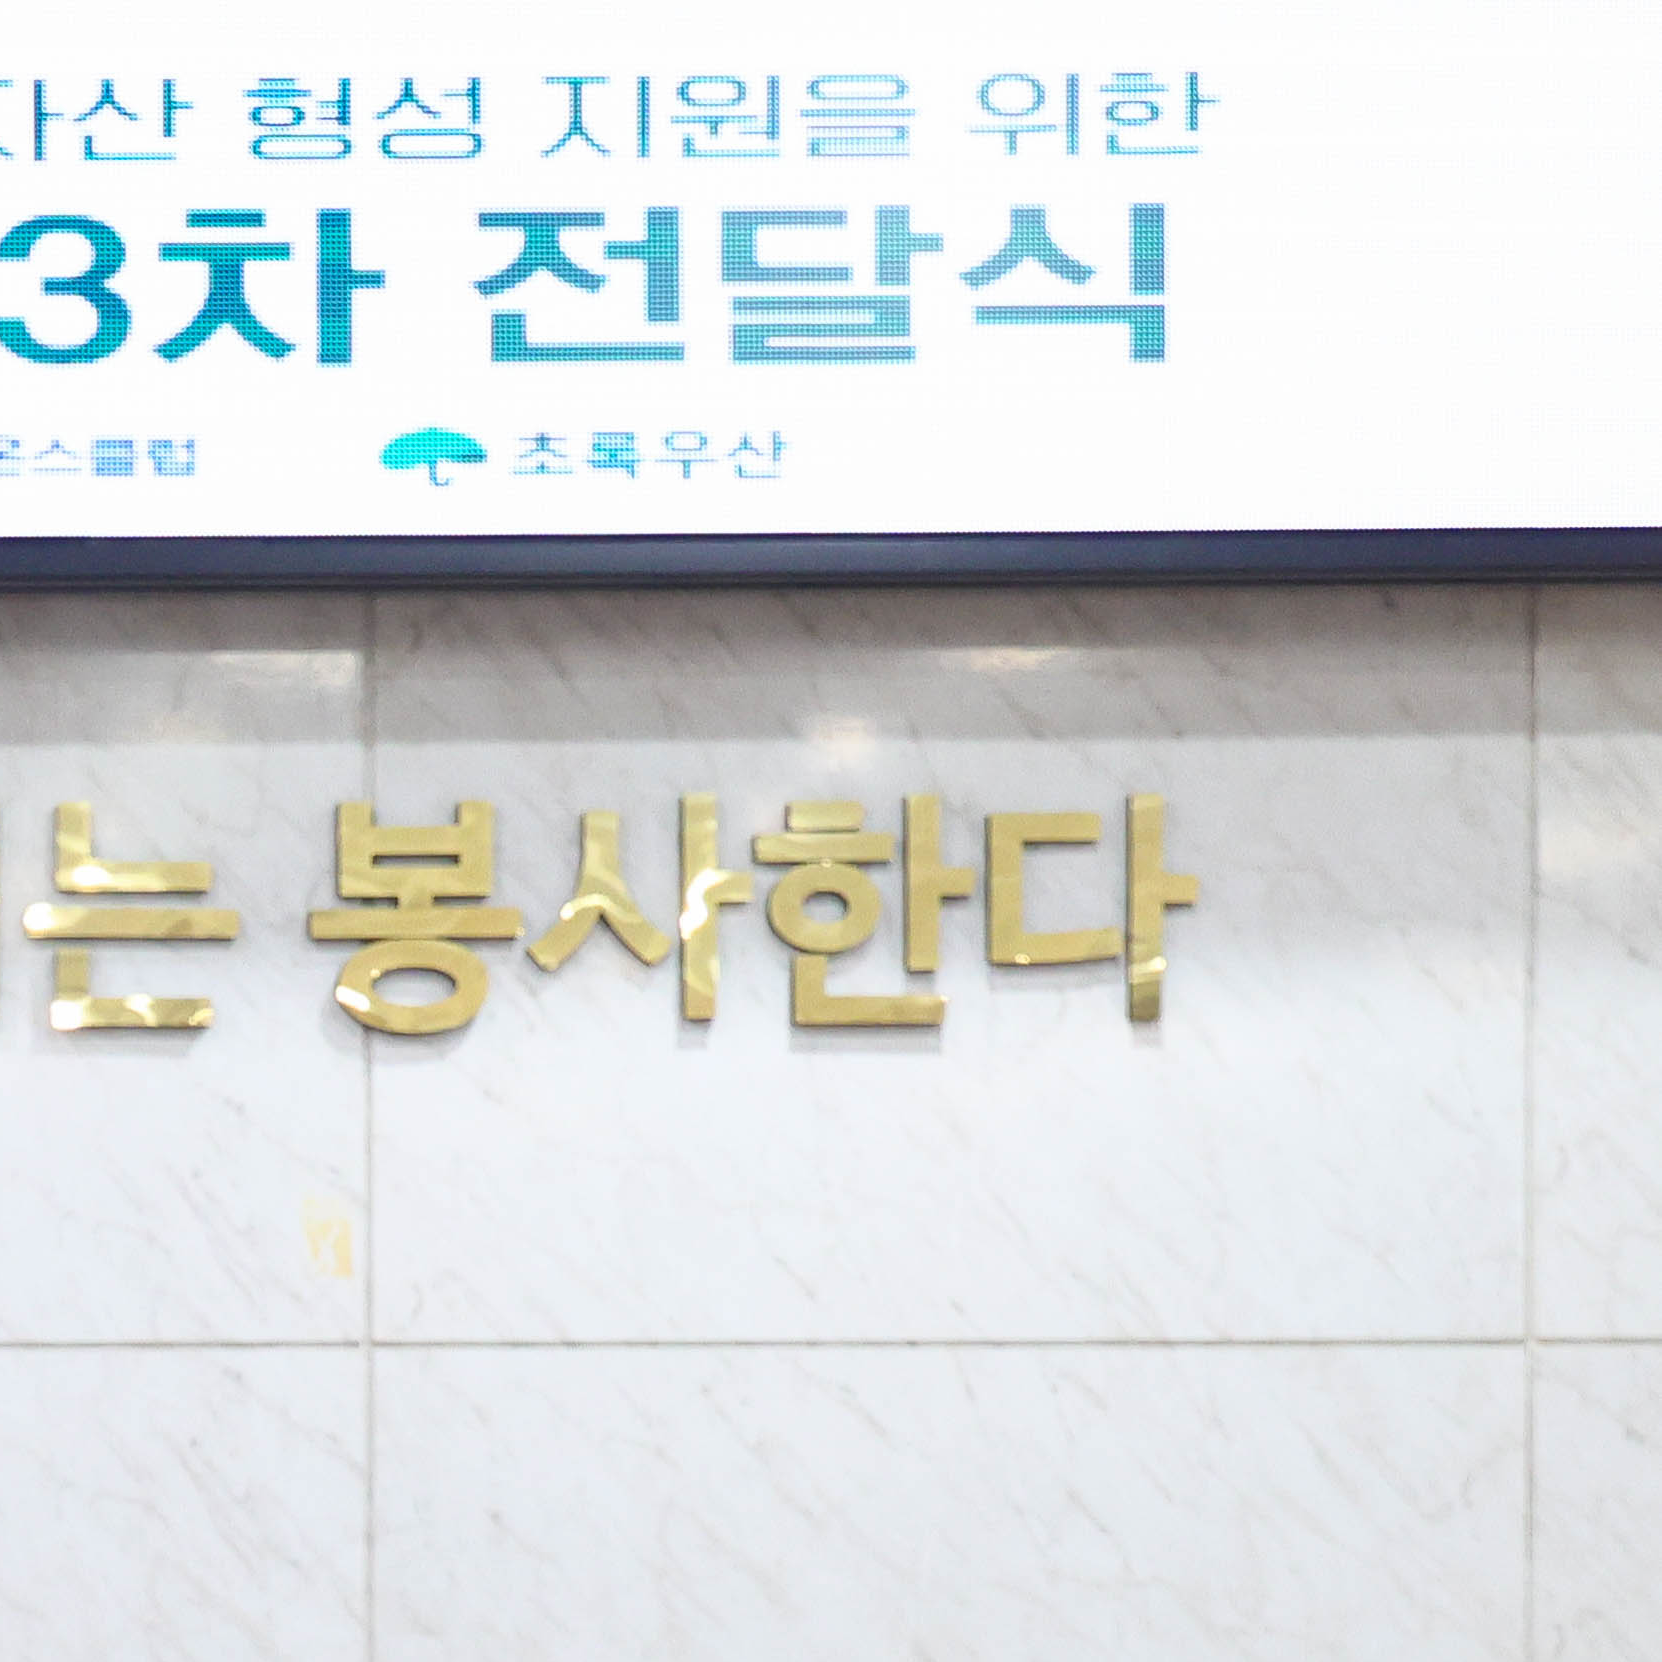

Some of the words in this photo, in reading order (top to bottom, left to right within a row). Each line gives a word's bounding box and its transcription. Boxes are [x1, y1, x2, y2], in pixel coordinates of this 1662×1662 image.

[242, 72, 487, 164] 형성
[540, 72, 917, 160] 지원을
[969, 71, 1221, 160] 위한
[468, 202, 1171, 367] 전달식
[509, 430, 787, 480] 초록우산
[308, 792, 1201, 1036] 봉사한다
